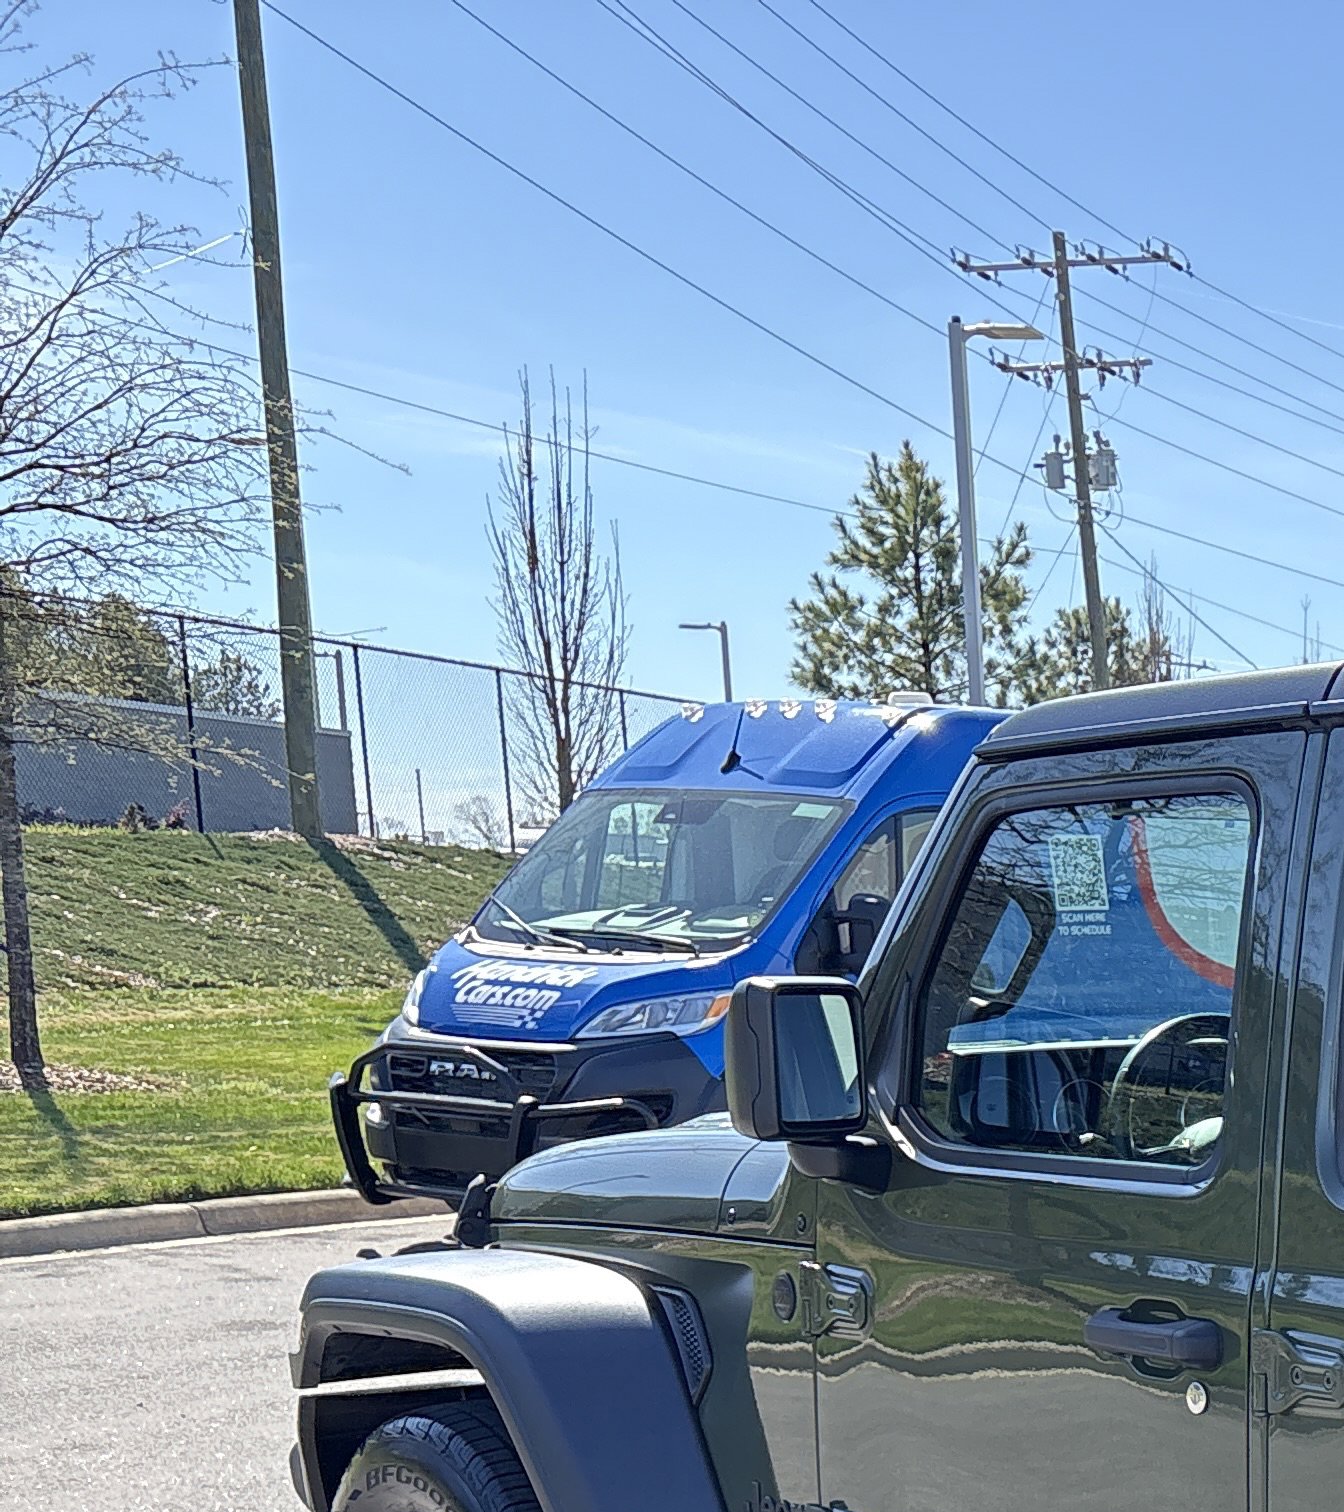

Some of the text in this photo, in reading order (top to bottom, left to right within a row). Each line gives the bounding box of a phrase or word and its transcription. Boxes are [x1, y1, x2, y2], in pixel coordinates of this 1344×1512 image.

[1061, 912, 1107, 924] SCAN HERE
[1057, 925, 1070, 937] TO
[454, 979, 562, 1011] Cars.com
